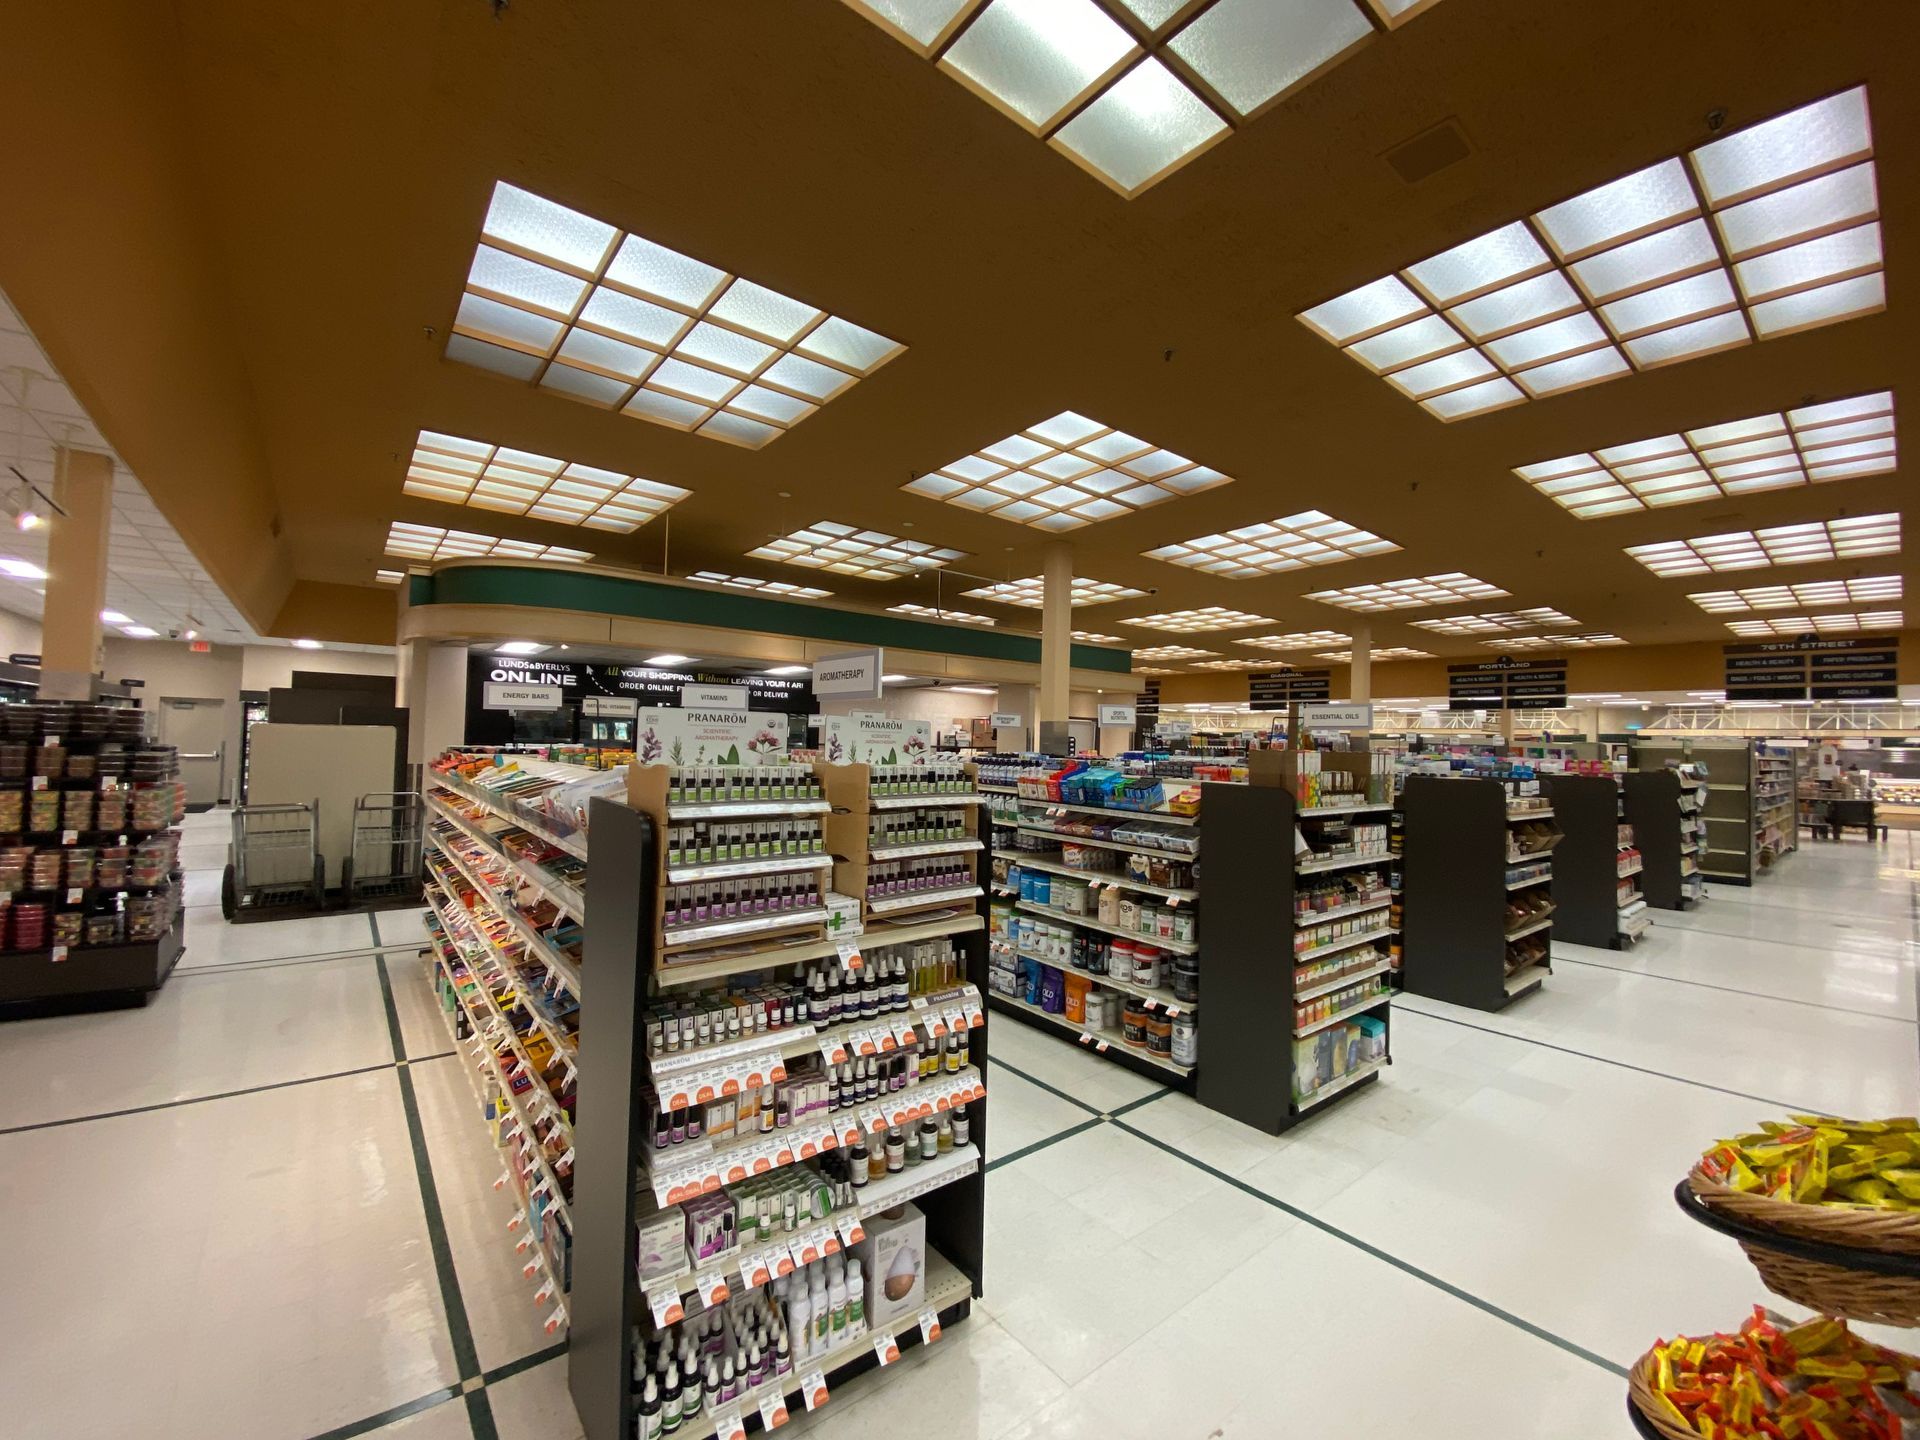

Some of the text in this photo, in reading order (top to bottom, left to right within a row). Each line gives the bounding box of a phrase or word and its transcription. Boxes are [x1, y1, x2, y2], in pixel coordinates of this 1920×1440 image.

[1800, 641, 1856, 649] STREET
[1479, 662, 1530, 670] PORTLAND
[490, 669, 577, 686] ONLINE
[606, 667, 619, 677] All
[620, 669, 647, 679] YOUR
[649, 671, 695, 682] SHOPPING,
[697, 673, 730, 684] Without
[731, 678, 764, 687] LEAVING
[765, 680, 786, 688] YOUR
[819, 669, 865, 682] AROMATHERAPY
[619, 682, 645, 690] ORDER
[647, 683, 675, 692] ONLINE
[700, 694, 728, 702] VITAMINS
[694, 734, 739, 742] AROMATHERAPY
[723, 1084, 738, 1092] DEAL
[698, 1091, 713, 1100] DEAL
[672, 1097, 687, 1107] DEAL
